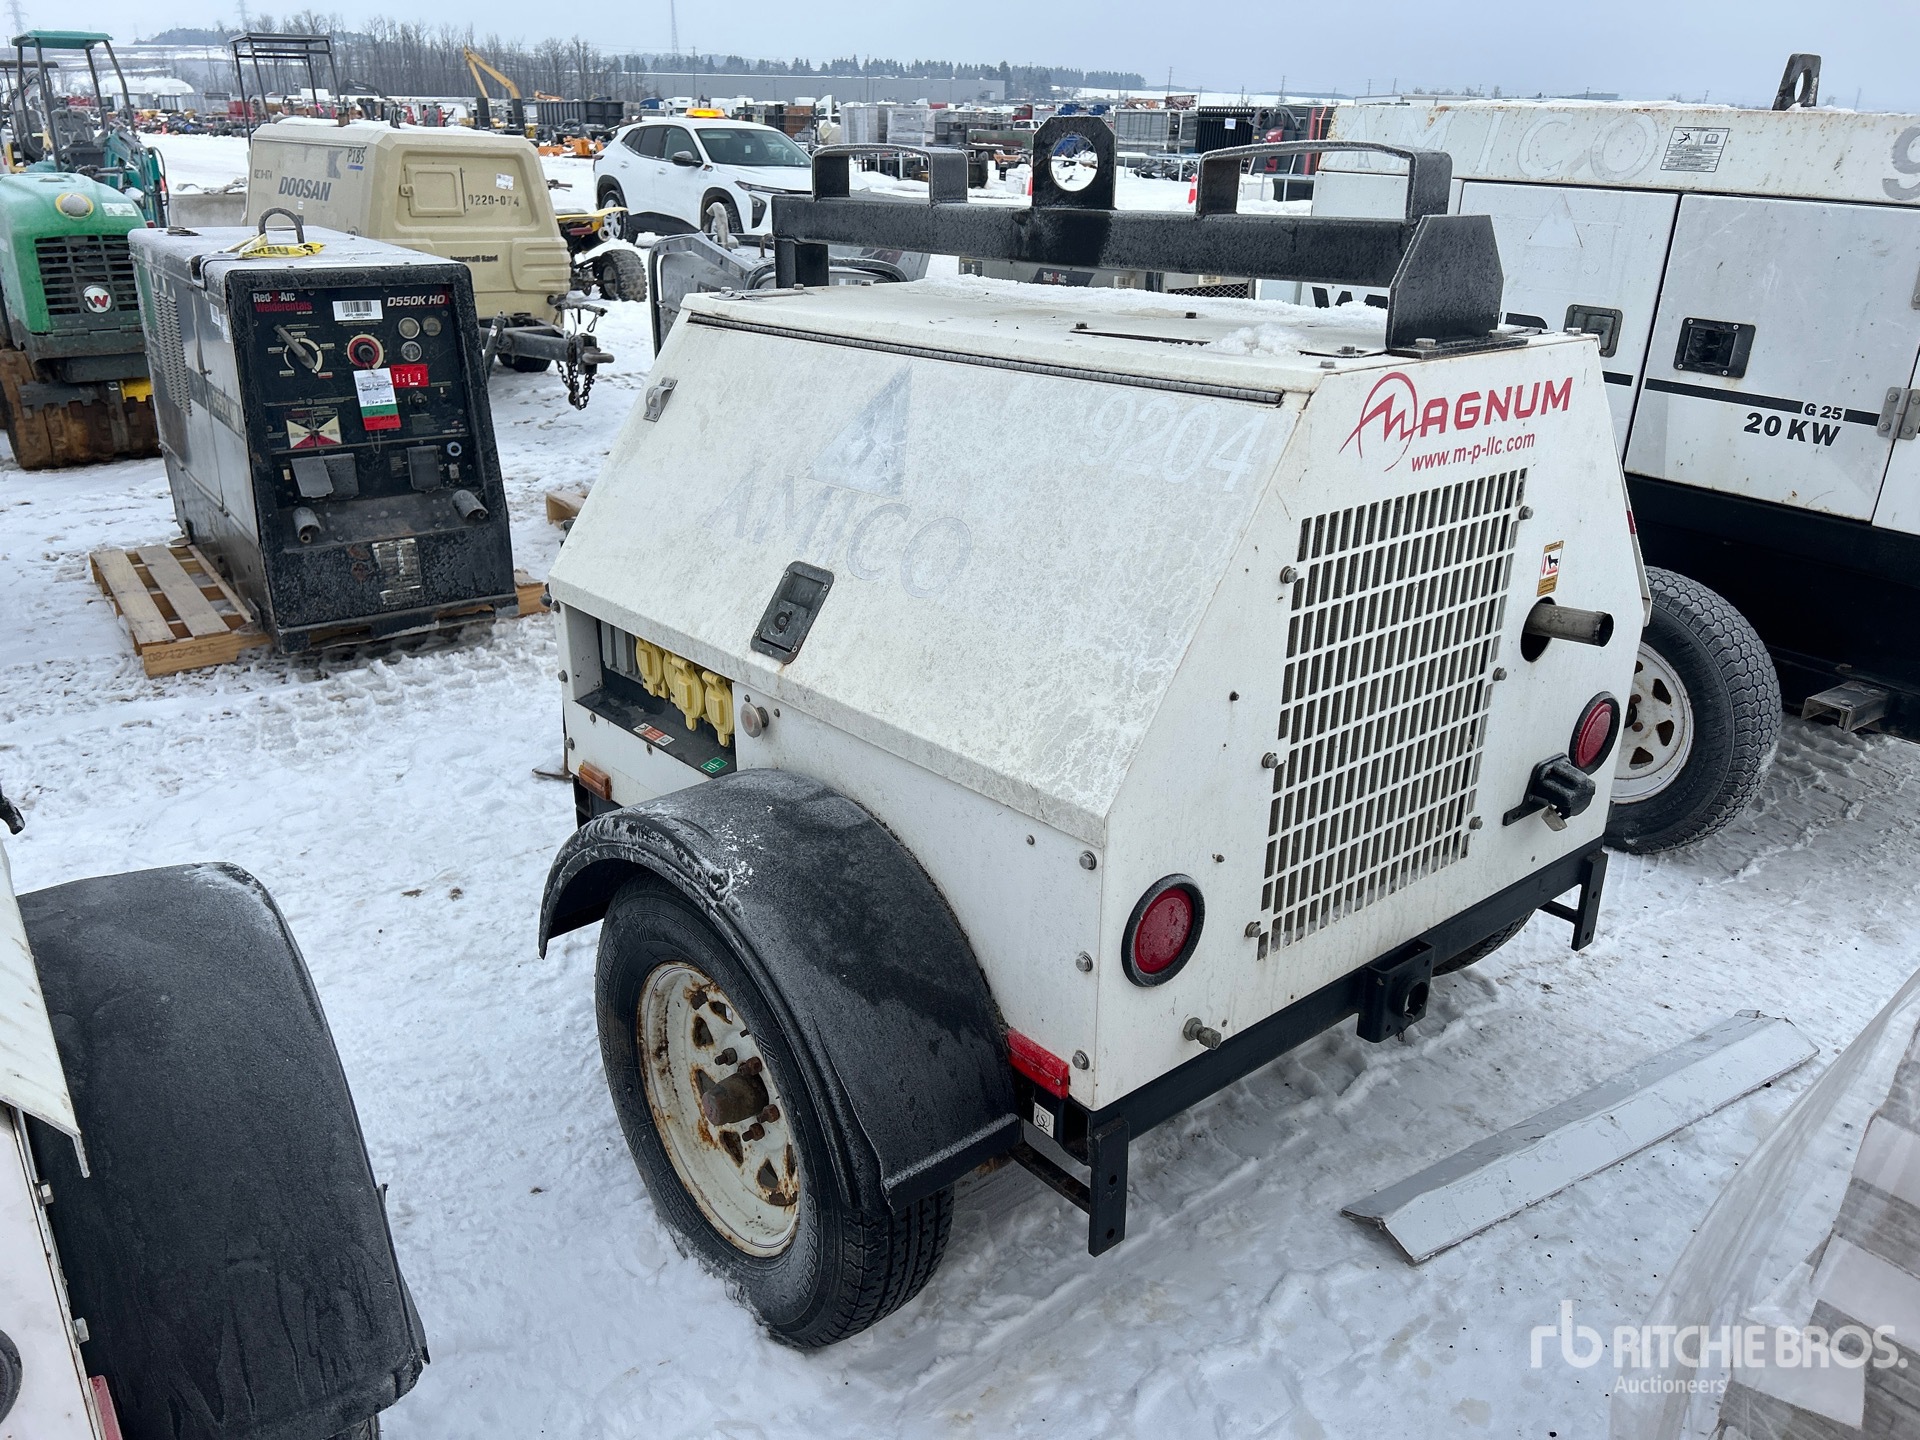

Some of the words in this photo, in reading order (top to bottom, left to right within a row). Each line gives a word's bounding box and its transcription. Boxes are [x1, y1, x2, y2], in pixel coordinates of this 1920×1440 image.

[346, 148, 366, 165] P185
[278, 176, 332, 201] DOOSAN
[252, 291, 296, 303] Red-D-Arc
[386, 295, 427, 307] D550K
[428, 294, 446, 305] HO
[255, 301, 313, 313] Welderentals
[1338, 376, 1573, 456] MAGNUM
[1804, 402, 1817, 417] G
[1820, 405, 1843, 421] 25
[1743, 412, 1782, 437] 20
[1786, 418, 1842, 447] KW
[1411, 432, 1536, 472] www.m-p-llc.com
